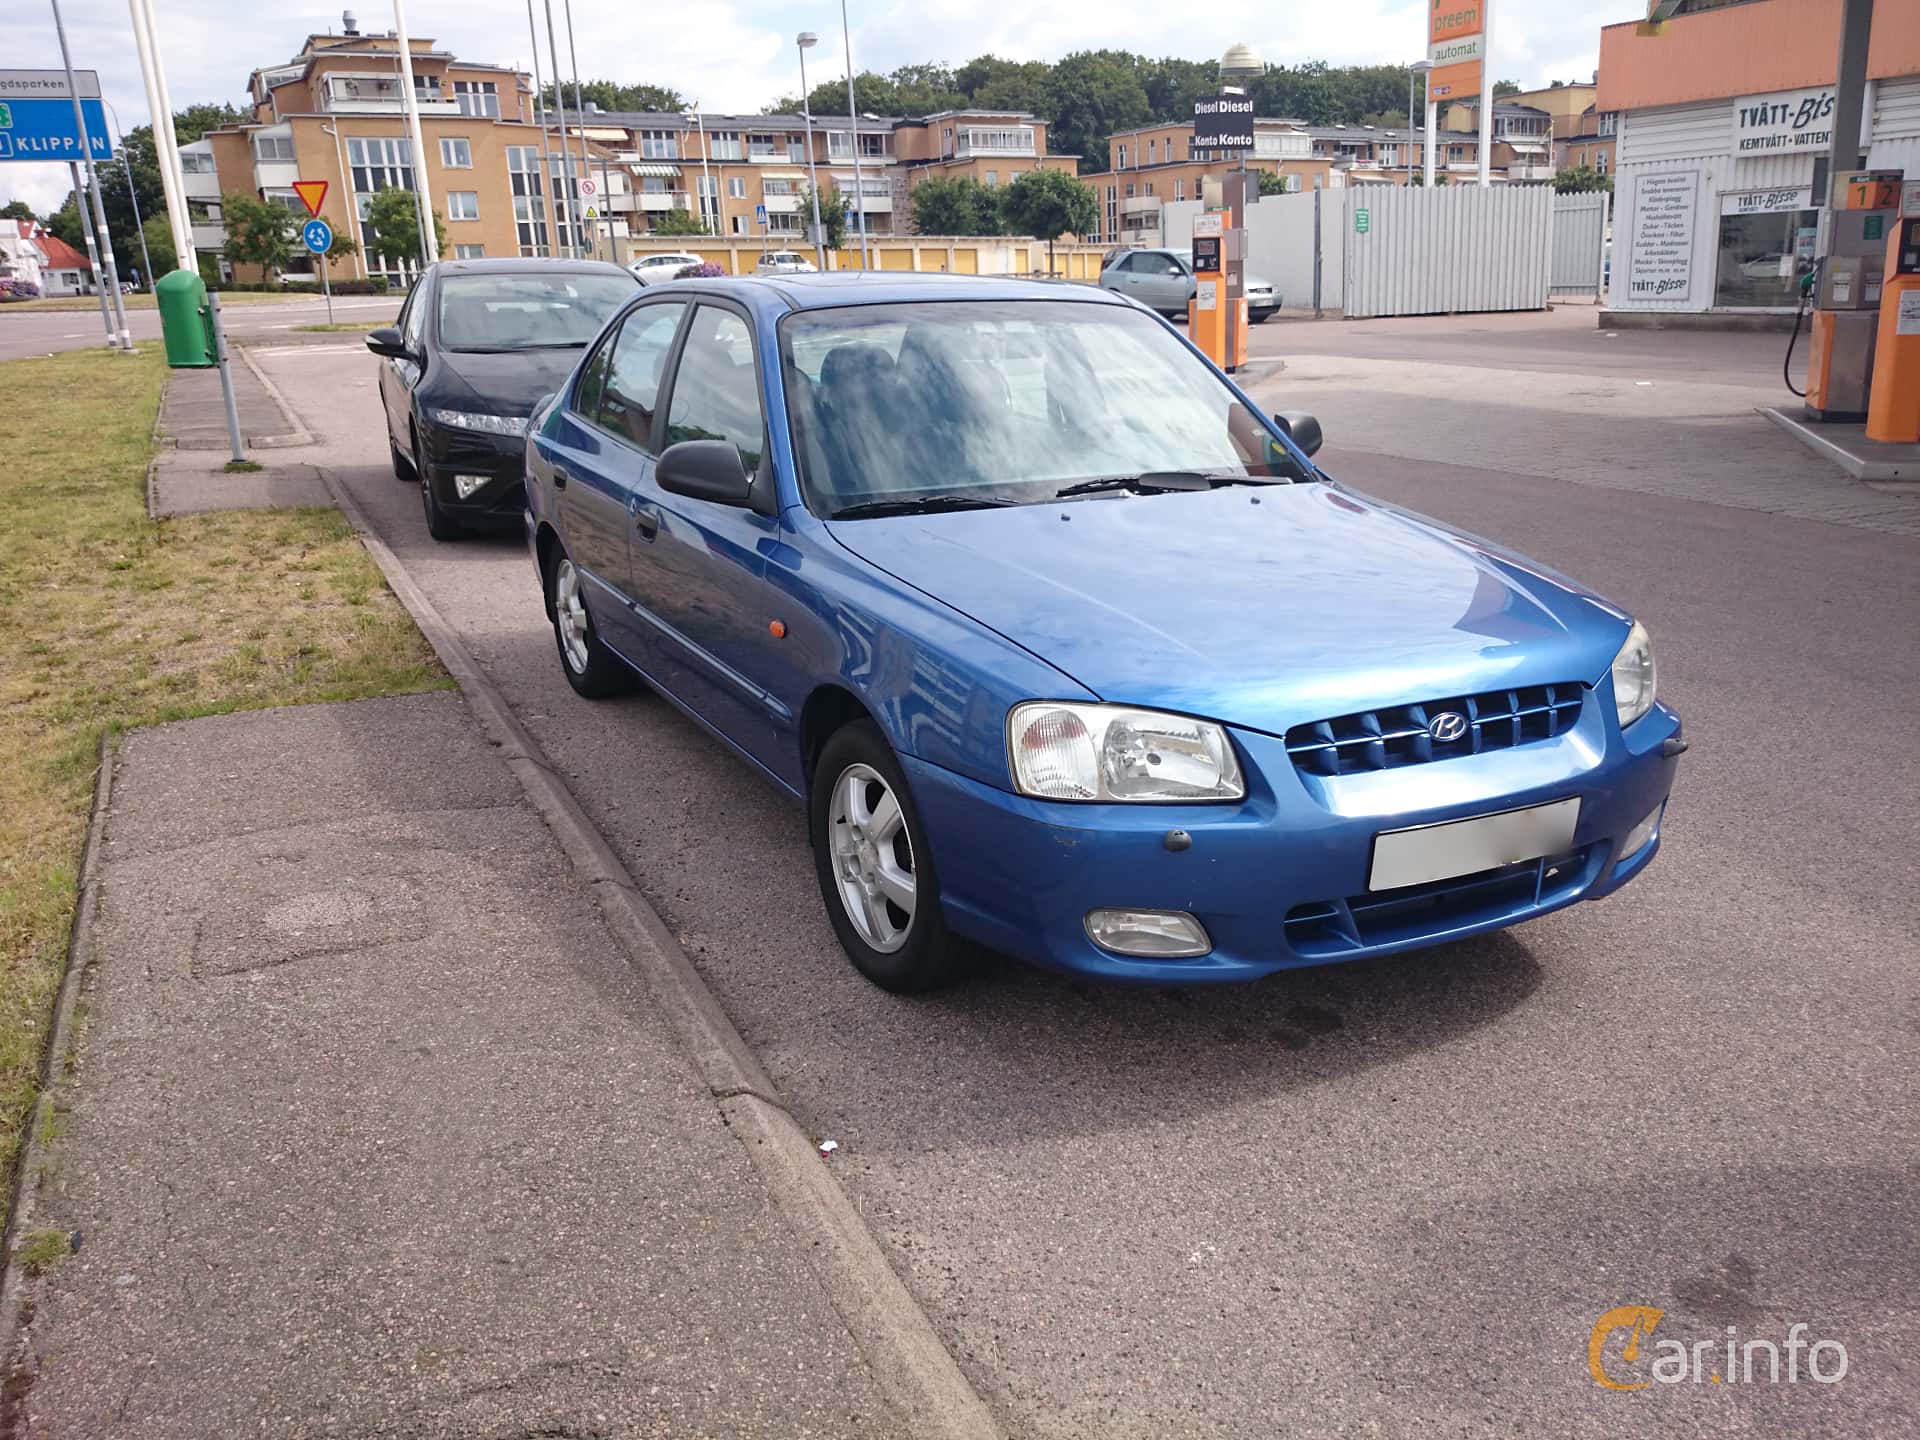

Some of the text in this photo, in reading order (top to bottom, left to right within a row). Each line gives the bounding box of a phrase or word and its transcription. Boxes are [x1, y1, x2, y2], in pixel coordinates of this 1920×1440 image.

[1433, 8, 1477, 32] preem
[1435, 40, 1477, 60] automat
[1194, 100, 1253, 114] Diesel Diesel
[1194, 133, 1253, 146] Konto Konto
[1739, 134, 1788, 151] KEMTVÄTT
[1738, 191, 1799, 209] TVÄTT-Bisse
[1857, 185, 1867, 206] 1
[1880, 184, 1893, 205] 2
[1632, 278, 1687, 295] TVÄTT-Bisse
